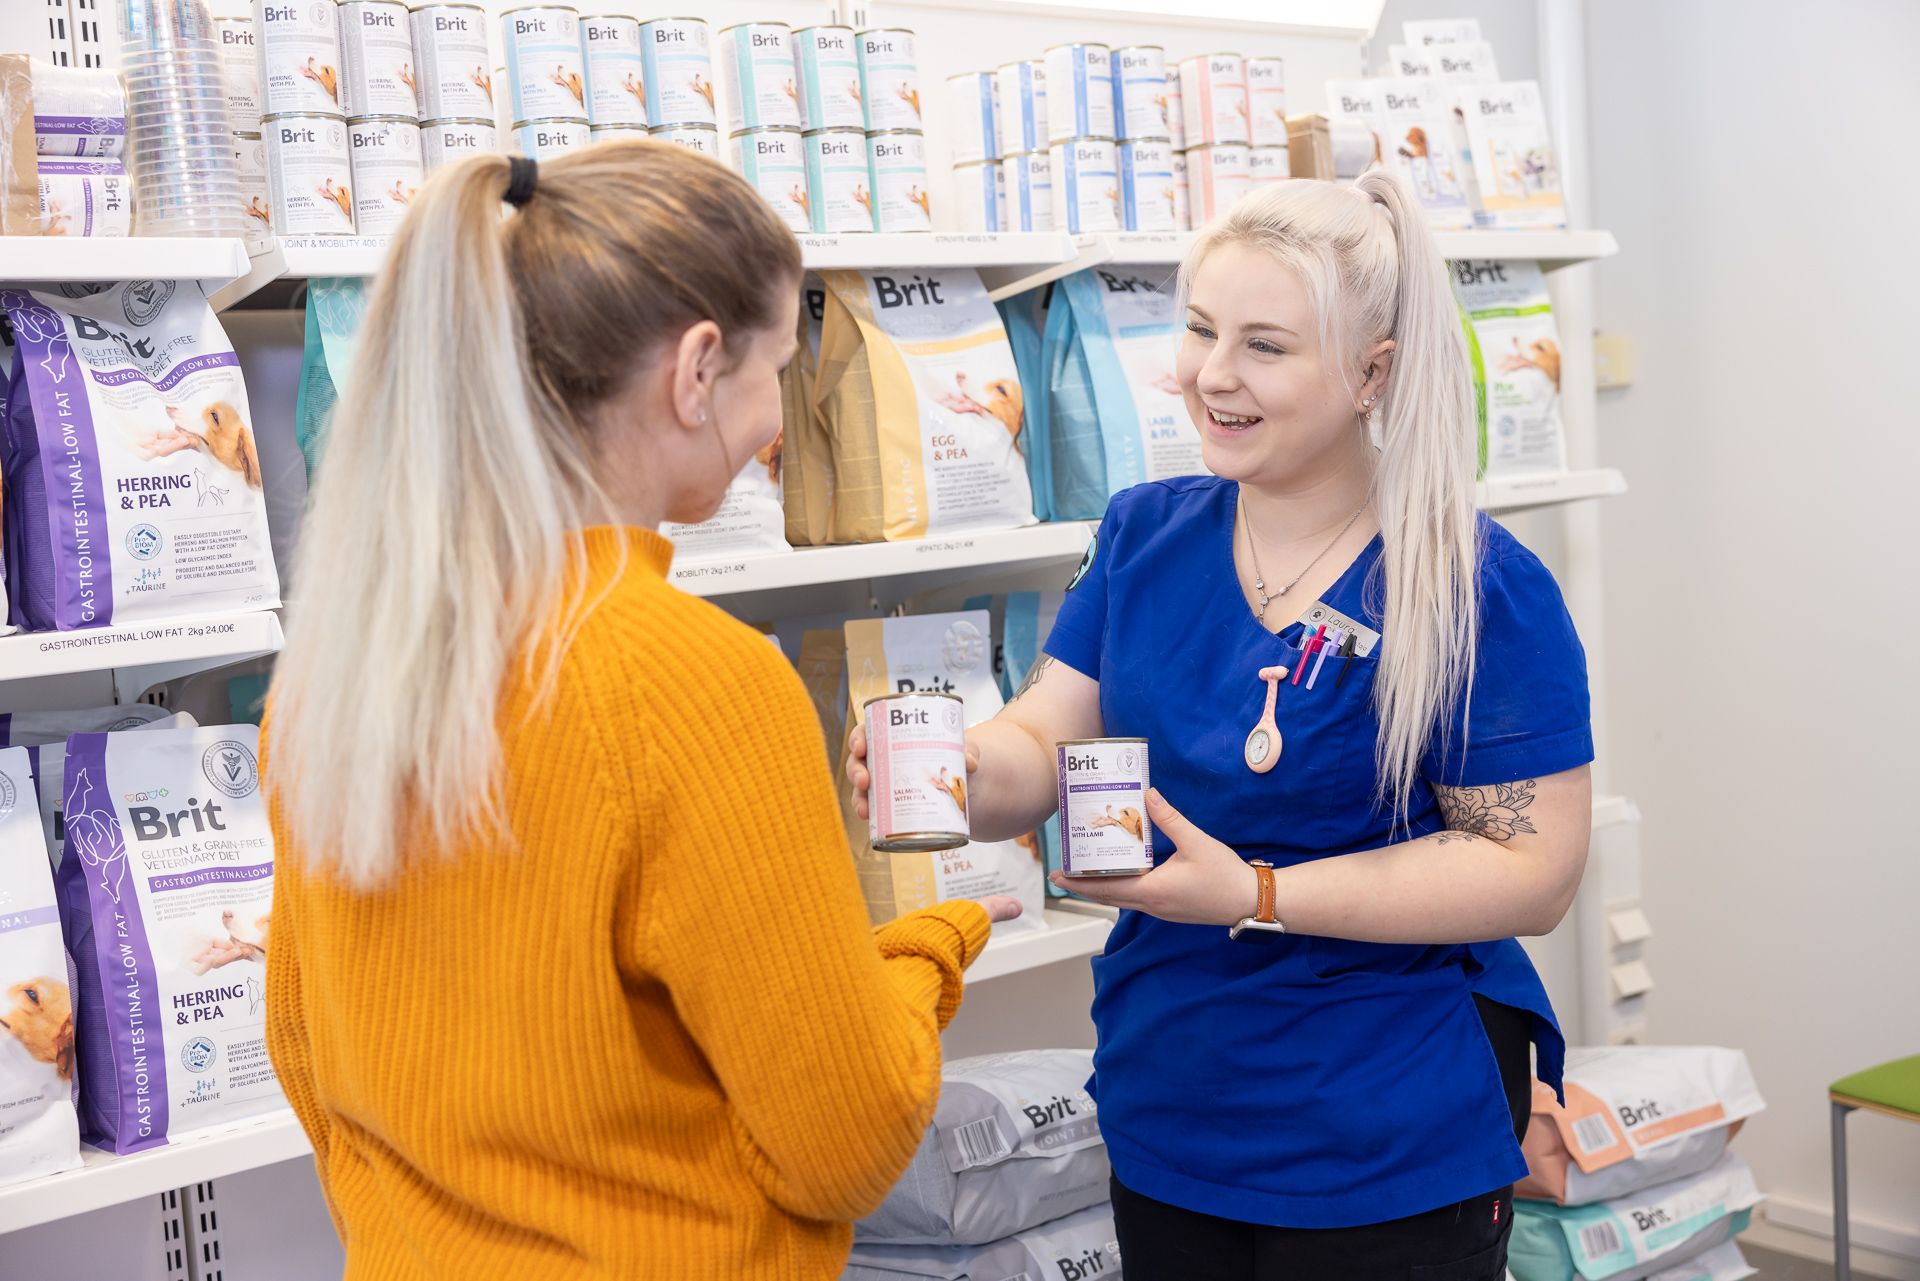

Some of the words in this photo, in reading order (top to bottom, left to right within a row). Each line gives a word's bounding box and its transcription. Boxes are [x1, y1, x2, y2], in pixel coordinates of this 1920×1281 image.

[264, 6, 297, 22] Brit
[362, 11, 395, 27] Brit
[435, 16, 468, 32] Brit
[516, 18, 547, 34] Brit
[222, 30, 254, 46] Brit
[588, 26, 618, 40] Brit
[656, 28, 685, 43] Brit
[752, 34, 780, 47] Brit
[817, 37, 844, 49] Brit
[866, 41, 893, 54] Brit
[1123, 56, 1148, 68] Brit
[1212, 62, 1233, 73] Brit
[1401, 60, 1430, 76] Brit
[1441, 58, 1472, 73] Brit
[1250, 67, 1273, 78] Brit
[1342, 96, 1373, 112] Brit
[1386, 93, 1420, 109] Brit
[1479, 99, 1515, 115] Brit
[281, 127, 315, 144] Brit
[353, 132, 385, 148] Brit
[444, 133, 476, 148] Brit
[537, 132, 568, 147] Brit
[757, 141, 786, 154] Brit
[822, 142, 849, 155] Brit
[876, 144, 903, 157] Brit
[1078, 149, 1103, 161] Brit
[1135, 150, 1160, 162] Brit
[1214, 154, 1238, 165] Brit
[1250, 157, 1274, 168] Brit
[104, 178, 121, 211] Brit
[284, 240, 309, 248] JOINT
[310, 240, 317, 248] &
[318, 240, 360, 248] MOBILITY
[362, 240, 377, 248] 400
[872, 275, 945, 310] Brit
[68, 312, 155, 359] Brit
[152, 355, 173, 378] DIET
[205, 356, 224, 366] FAT
[54, 391, 73, 418] FAT
[931, 434, 955, 447] EGG
[934, 451, 942, 461] &
[946, 448, 968, 460] PEA
[116, 474, 192, 493] HERRING
[120, 496, 134, 510] &
[138, 493, 171, 509] PEA
[61, 421, 95, 623] GASTROINTESTINAL-LOW
[193, 531, 222, 539] DIGESTIBLE
[222, 529, 242, 537] DIETARY
[216, 542, 237, 550] CONTENT
[915, 543, 943, 553] HEPATIC
[943, 543, 954, 551] 2kg
[175, 565, 204, 574] PROBIOTIC
[216, 562, 241, 570] BALANCED
[241, 559, 254, 567] RATIO
[187, 555, 217, 563] GLYCAEMIC
[183, 571, 206, 579] SOLUBLE
[217, 568, 245, 577] INSOLUBLE
[675, 567, 709, 579] MOBILITY
[711, 567, 723, 575] 2kg
[131, 583, 167, 593] TAURINE
[1327, 615, 1355, 634] Laura
[39, 632, 139, 652] GASTROINTESTINAL
[140, 629, 163, 641] LOW
[165, 627, 183, 638] FAT
[187, 626, 204, 638] 2kg
[890, 708, 929, 727] Brit
[1067, 754, 1099, 772] Brit
[128, 797, 227, 842] Brit
[141, 845, 189, 861] GLUTEN
[192, 843, 201, 852] &
[204, 838, 267, 851] GRAIN-FREE
[144, 851, 216, 871] VETERINARY
[218, 851, 241, 861] DIET
[943, 866, 951, 874] &
[954, 860, 974, 873] PEA
[154, 867, 269, 889] GASTROINTESTINAL-LOW
[116, 912, 129, 938] FAT
[172, 984, 244, 1009] HERRING
[176, 1011, 190, 1025] &
[193, 1006, 225, 1024] PEA
[120, 943, 152, 1138] GASTROINTESTINAL-LOW
[227, 1042, 245, 1050] EASILY
[227, 1047, 251, 1057] HERRING
[240, 1060, 269, 1071] GLYCAEMIC
[229, 1072, 257, 1083] PROBIOTIC
[237, 1078, 259, 1087] SOLUBLE
[185, 1092, 221, 1105] TAURINE
[1022, 1095, 1078, 1129] Brit
[1618, 1098, 1662, 1127] Brit
[1039, 1127, 1076, 1149] JOINT
[1631, 1206, 1671, 1232] Brit
[1055, 1247, 1104, 1281] Brit
